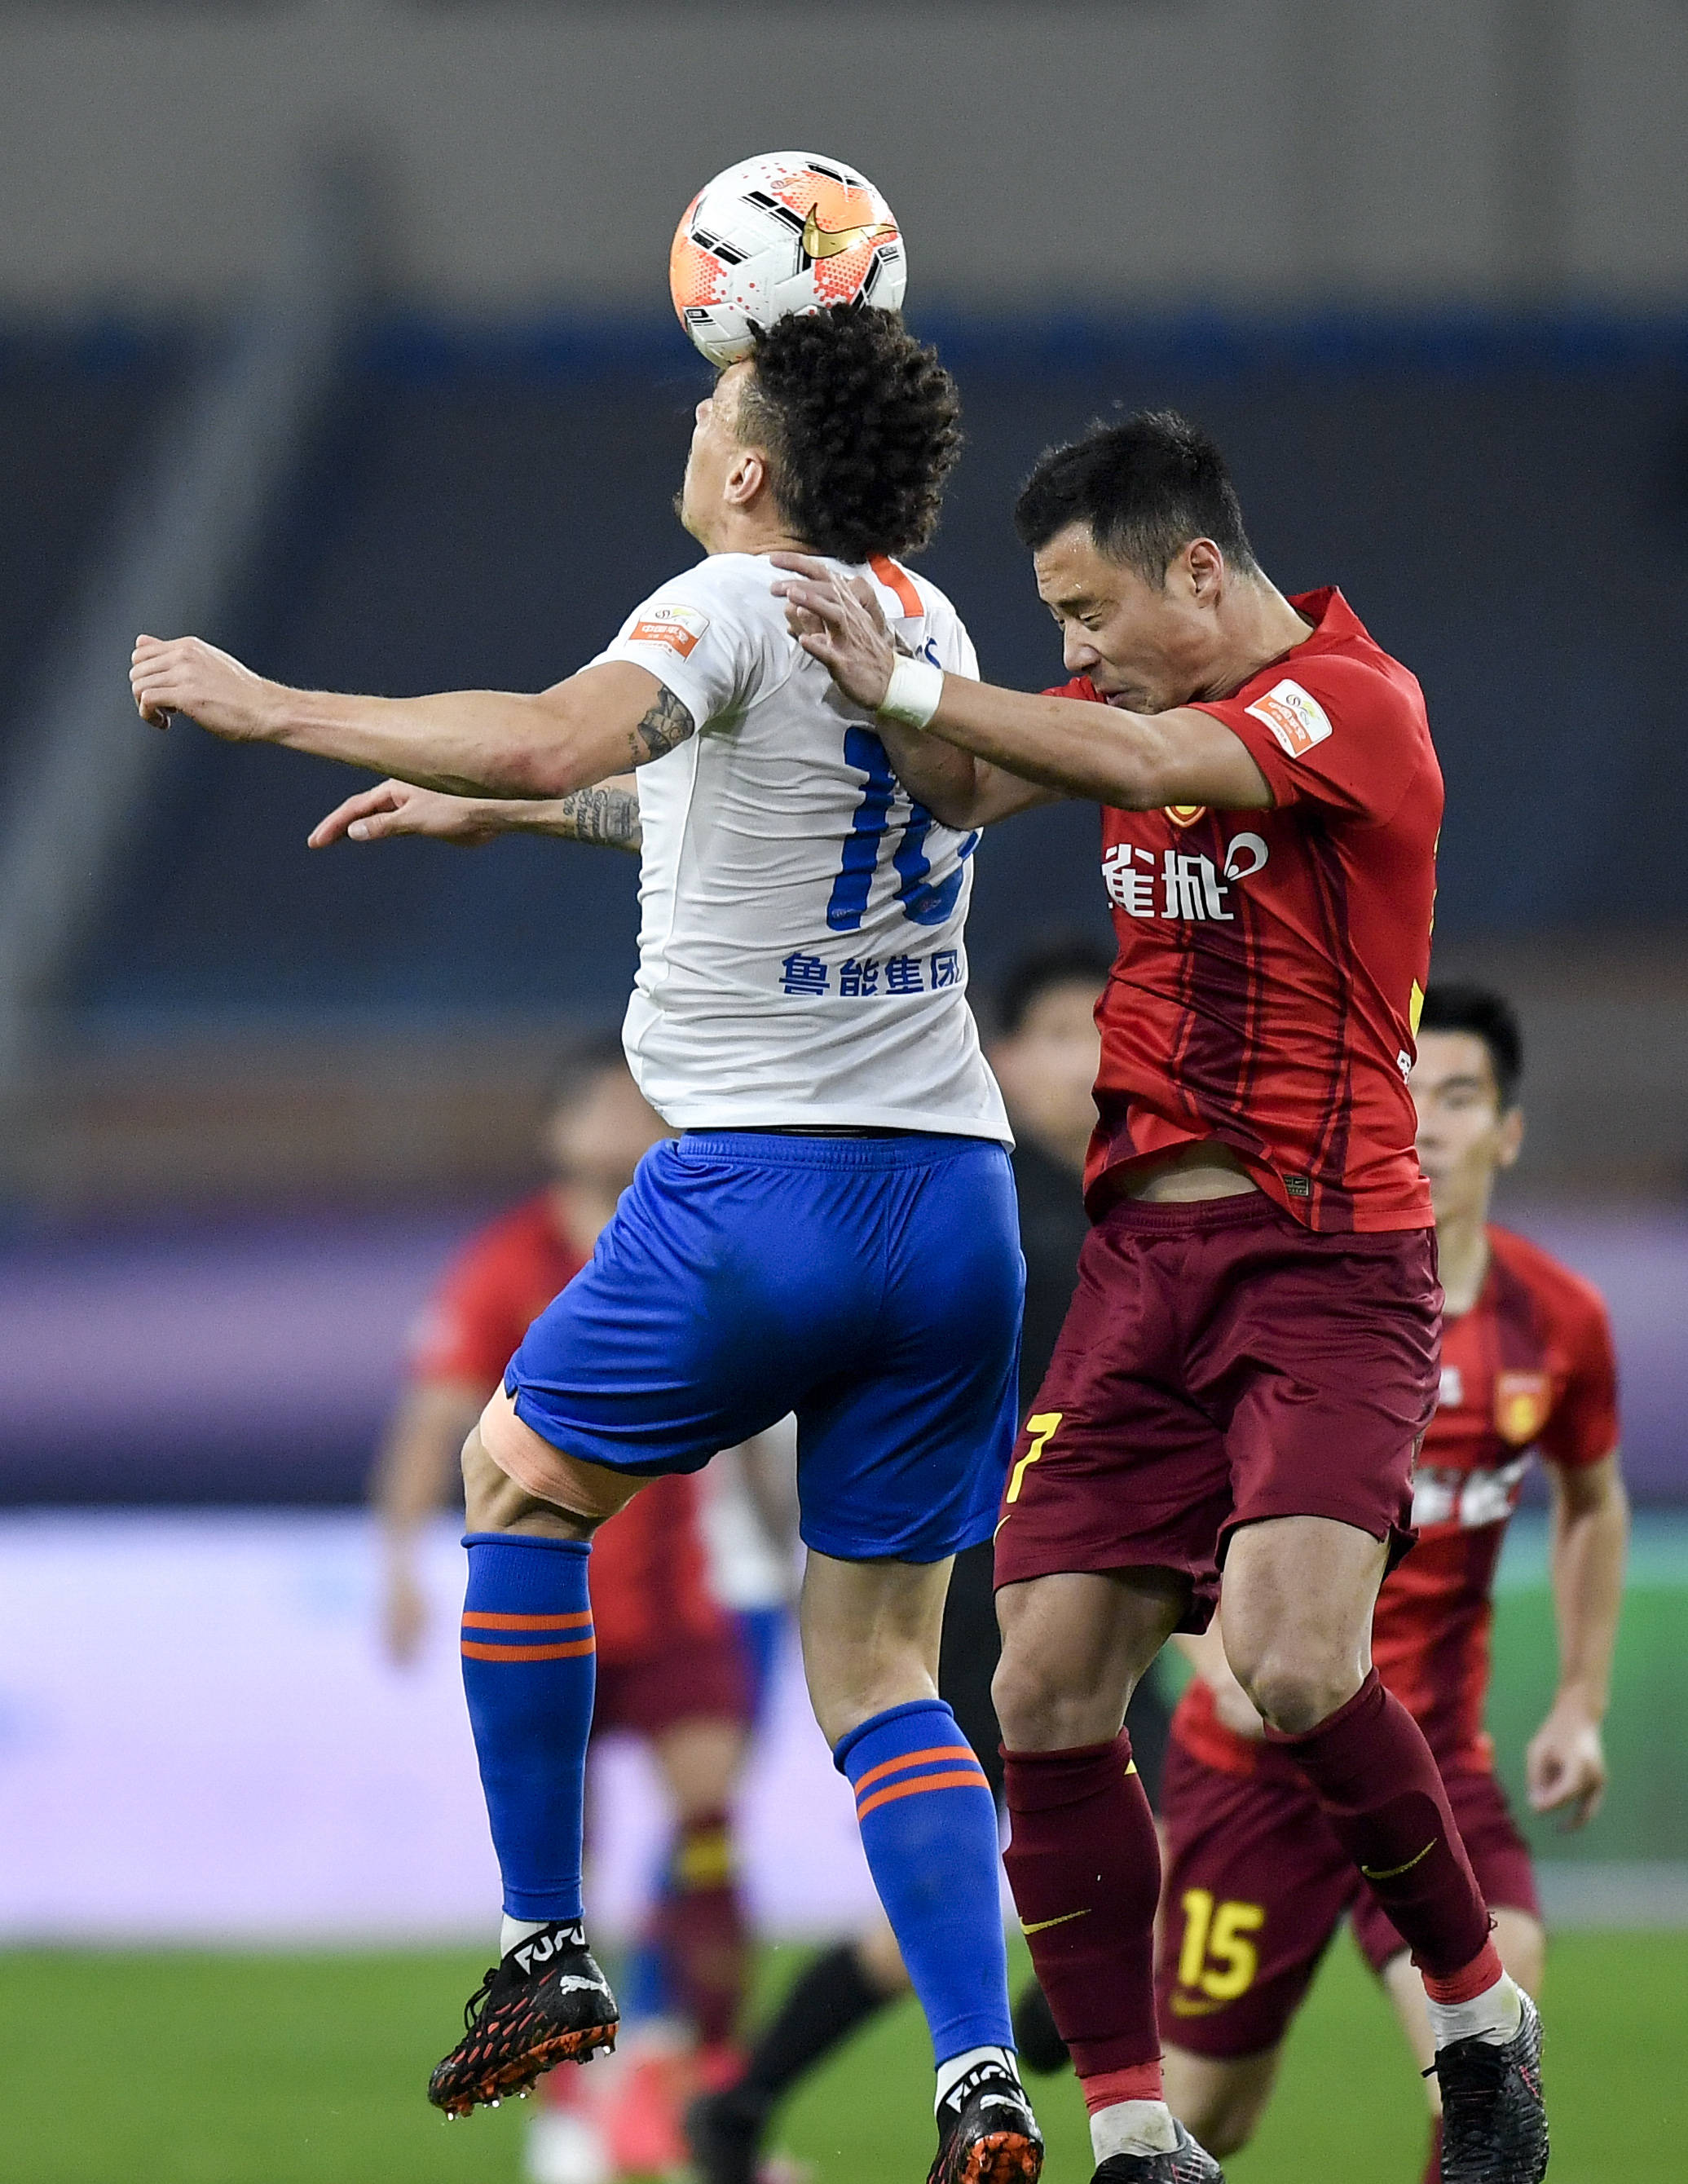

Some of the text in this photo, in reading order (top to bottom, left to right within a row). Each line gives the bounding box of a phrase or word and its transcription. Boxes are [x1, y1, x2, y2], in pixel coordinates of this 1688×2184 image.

[778, 949, 960, 997] 鲁能集团
[1179, 1886, 1266, 2001] 15
